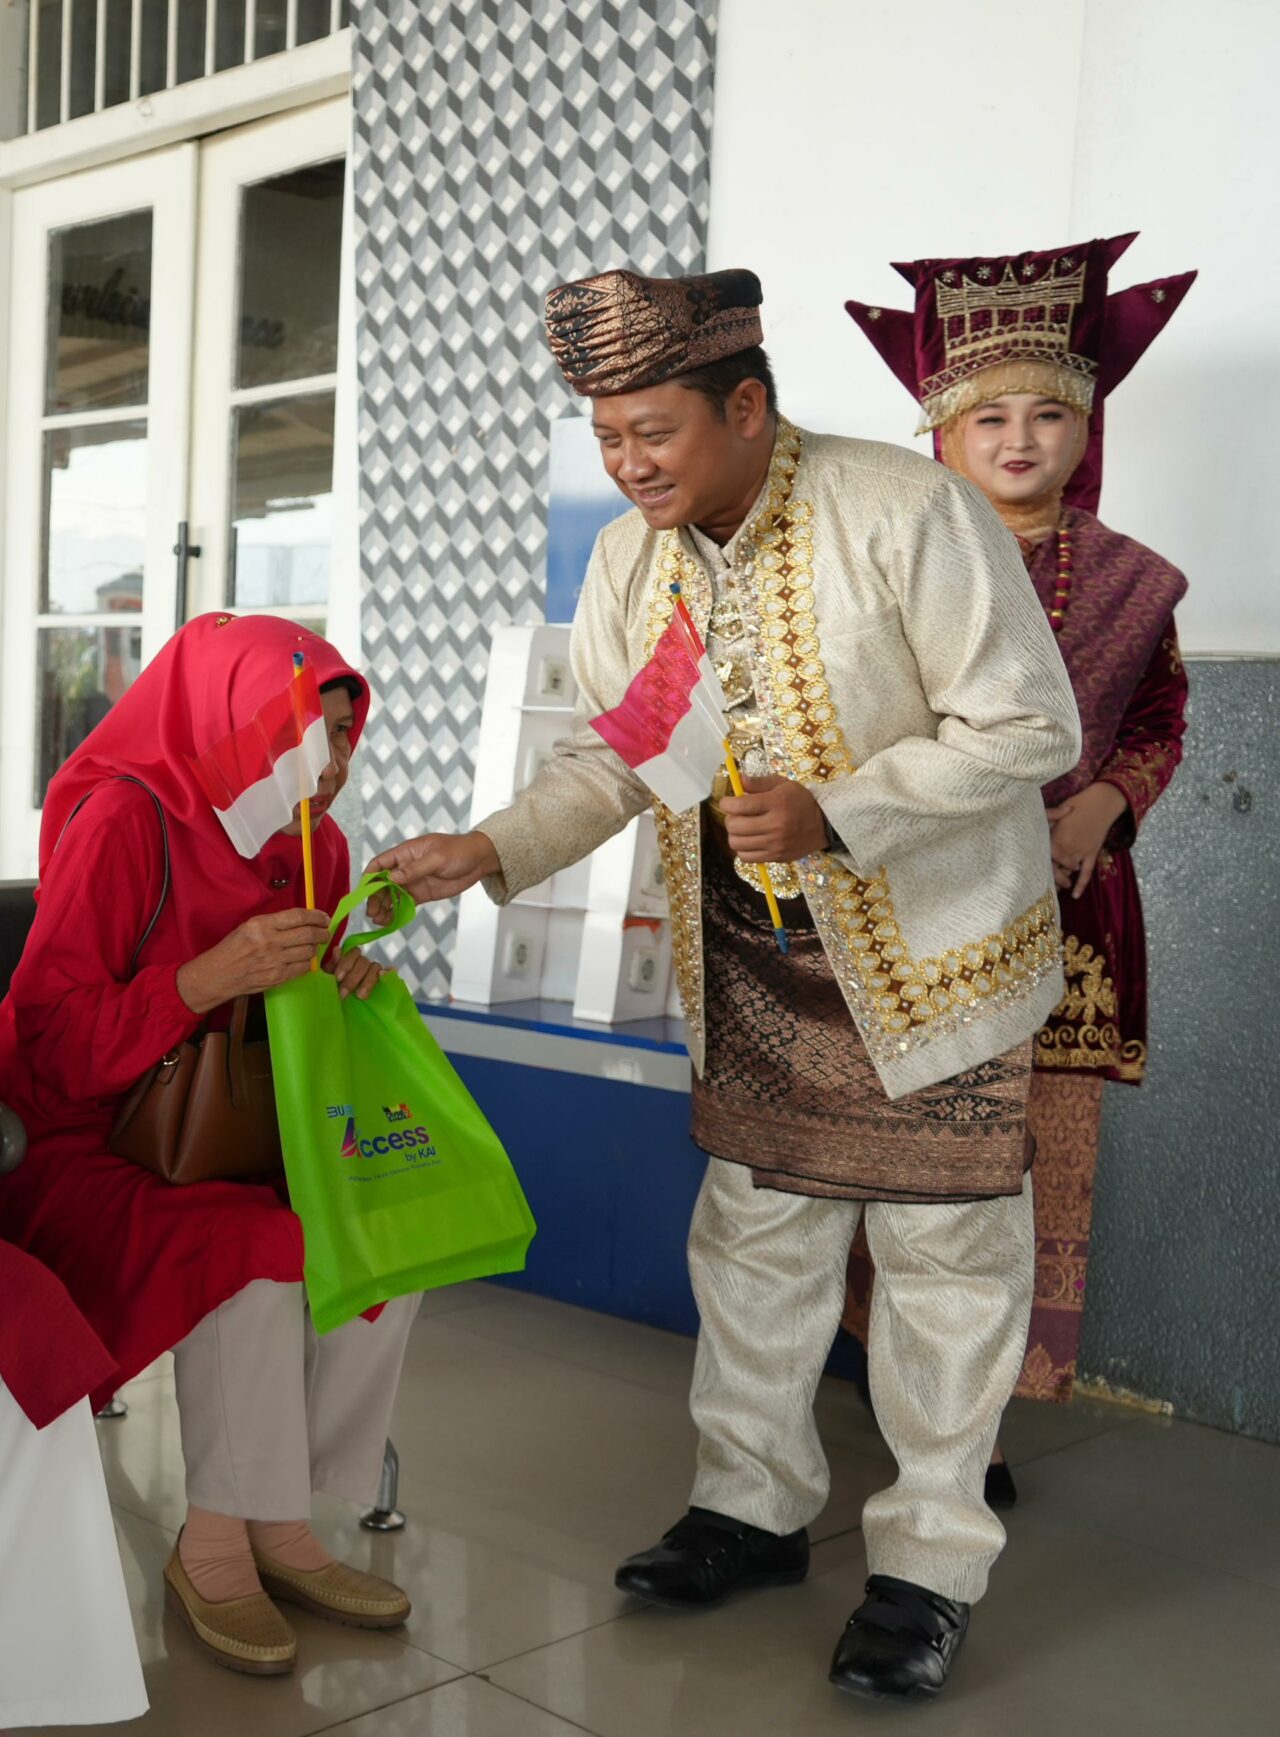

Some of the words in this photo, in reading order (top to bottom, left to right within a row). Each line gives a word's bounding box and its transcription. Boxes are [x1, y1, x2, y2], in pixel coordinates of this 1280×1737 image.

[341, 1117, 430, 1159] Access
[405, 1151, 417, 1164] by
[418, 1146, 437, 1159] KAI
